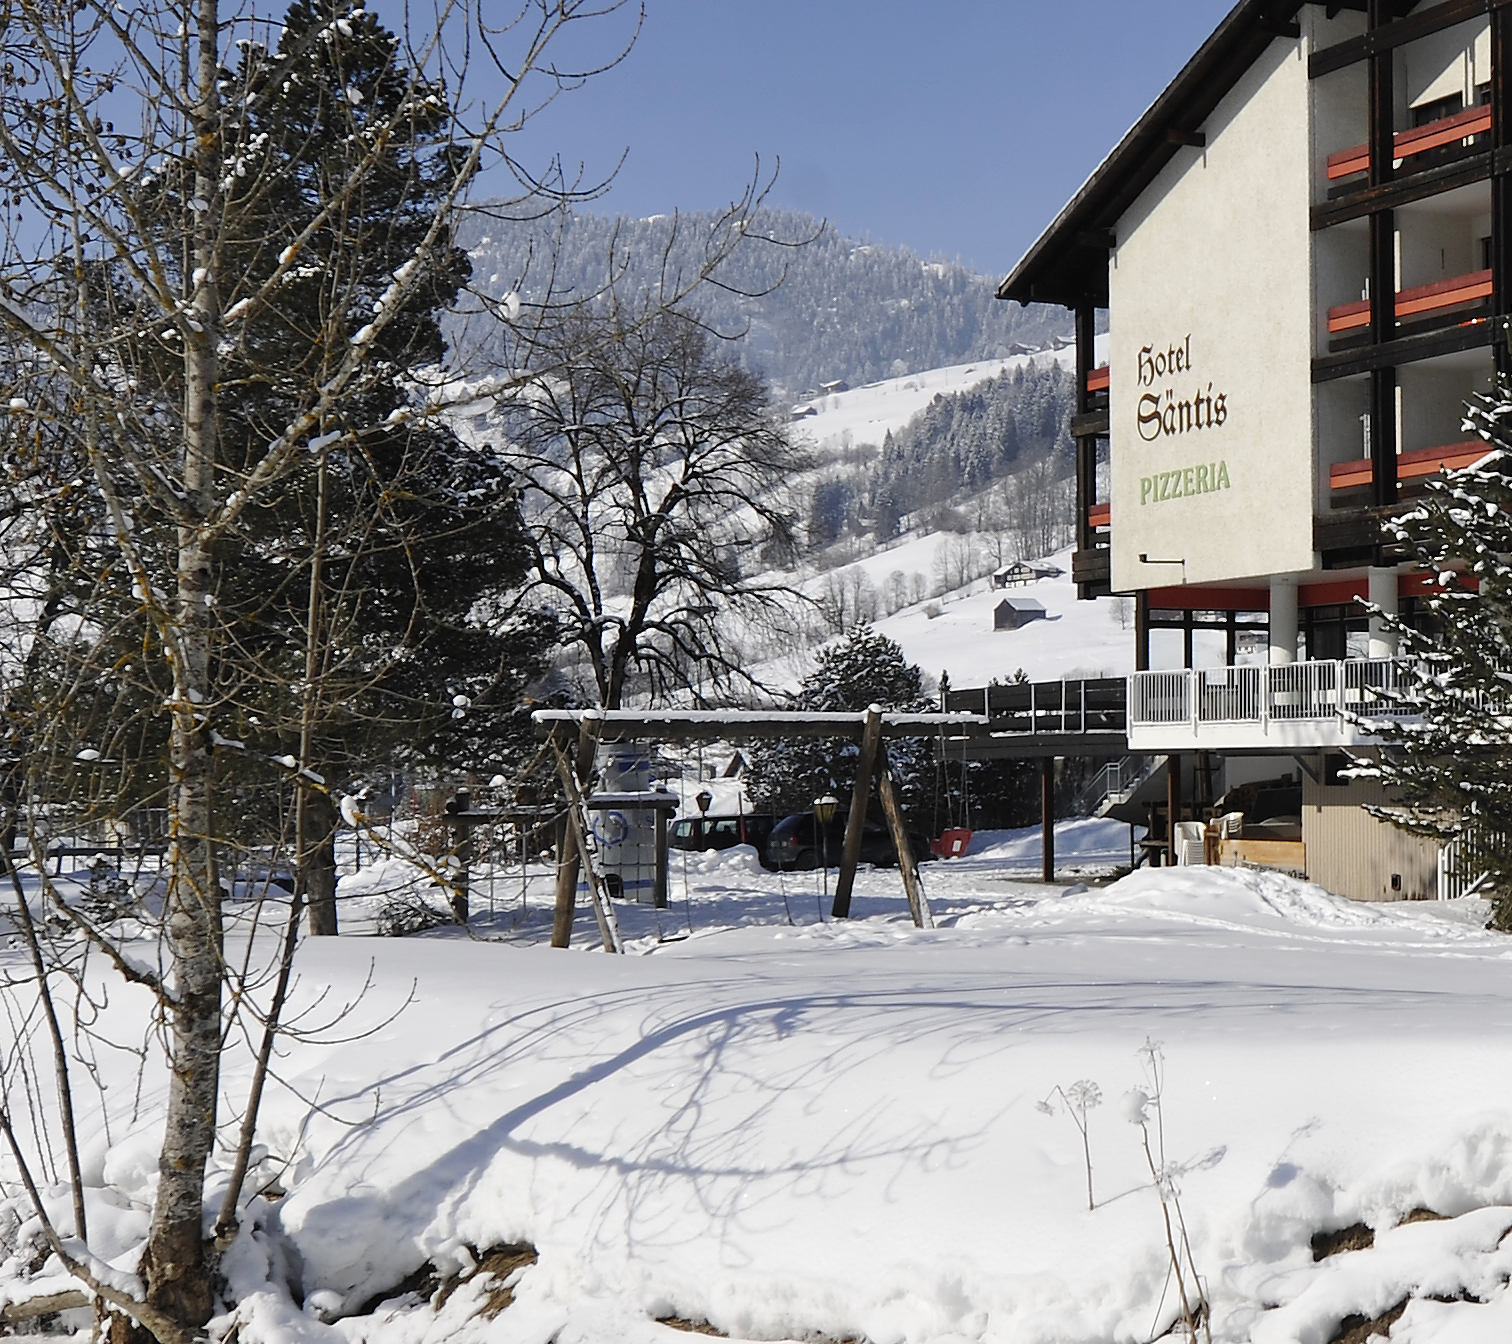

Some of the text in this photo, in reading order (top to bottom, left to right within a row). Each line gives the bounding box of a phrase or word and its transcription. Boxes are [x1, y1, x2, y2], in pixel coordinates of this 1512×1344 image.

[1137, 333, 1192, 387] Hotel
[1137, 381, 1229, 442] Säntis
[1140, 460, 1231, 505] PIZZERIA
